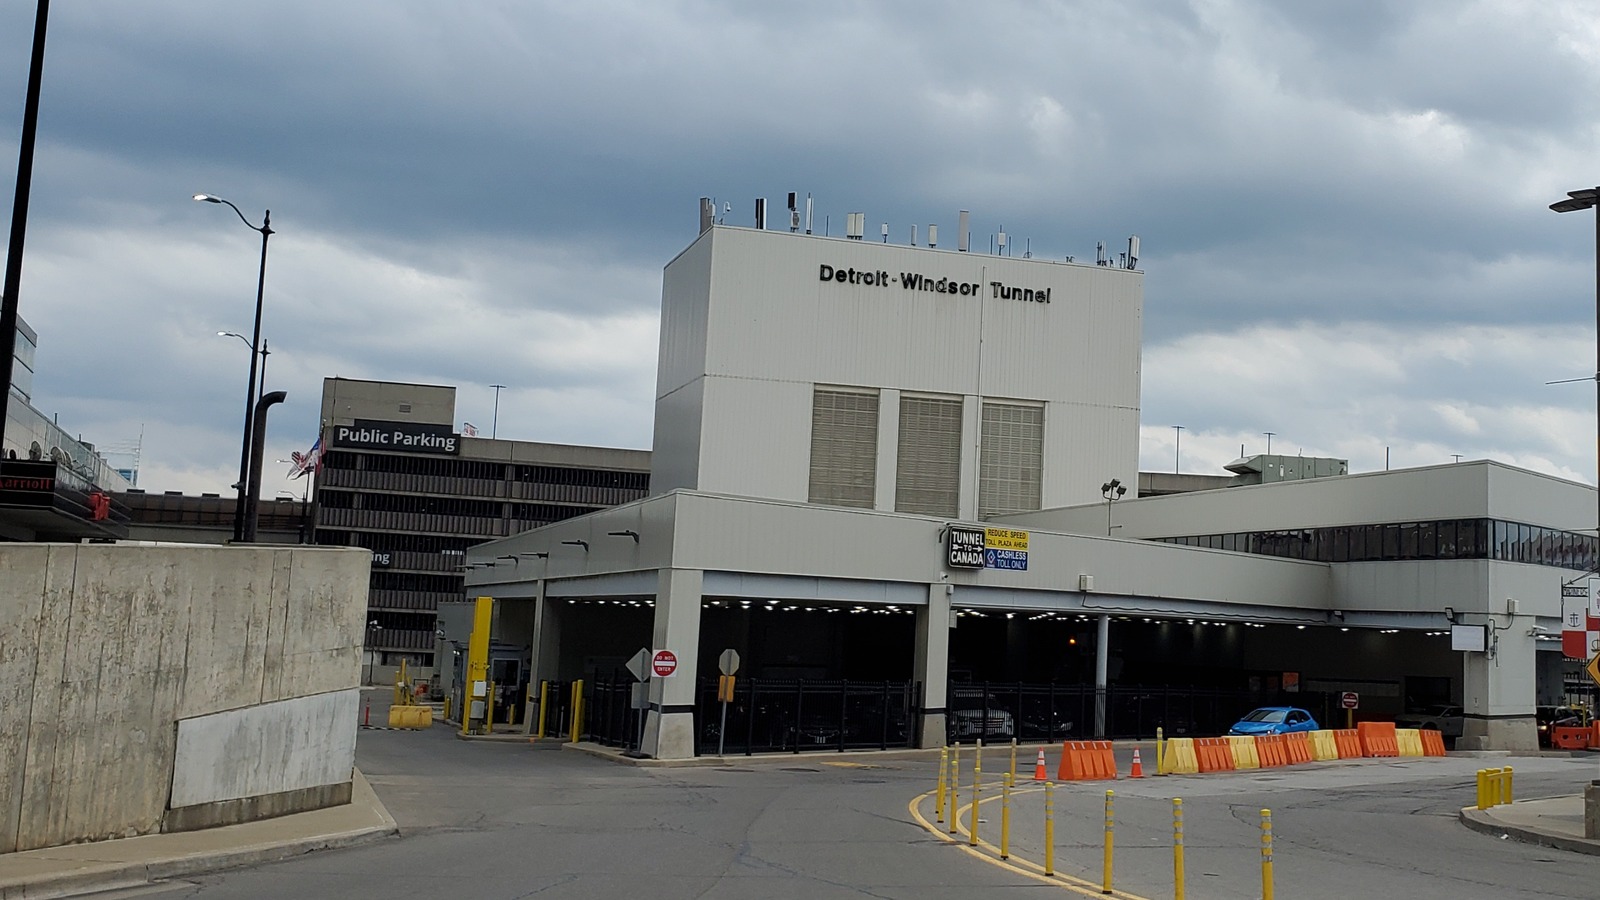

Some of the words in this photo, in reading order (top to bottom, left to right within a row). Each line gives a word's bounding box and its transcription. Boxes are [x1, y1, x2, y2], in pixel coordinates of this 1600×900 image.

[990, 281, 1051, 303] Tunnel
[338, 427, 389, 444] Public
[393, 431, 456, 452] Parking
[0, 478, 50, 490] arriott
[952, 531, 984, 545] TUNNEL
[988, 529, 1008, 538] REDUCE
[986, 538, 996, 546] TOLL
[1013, 541, 1028, 549] AHEAD
[371, 552, 390, 565] ing
[951, 551, 984, 564] CANADA
[997, 551, 1026, 559] CASHLESS
